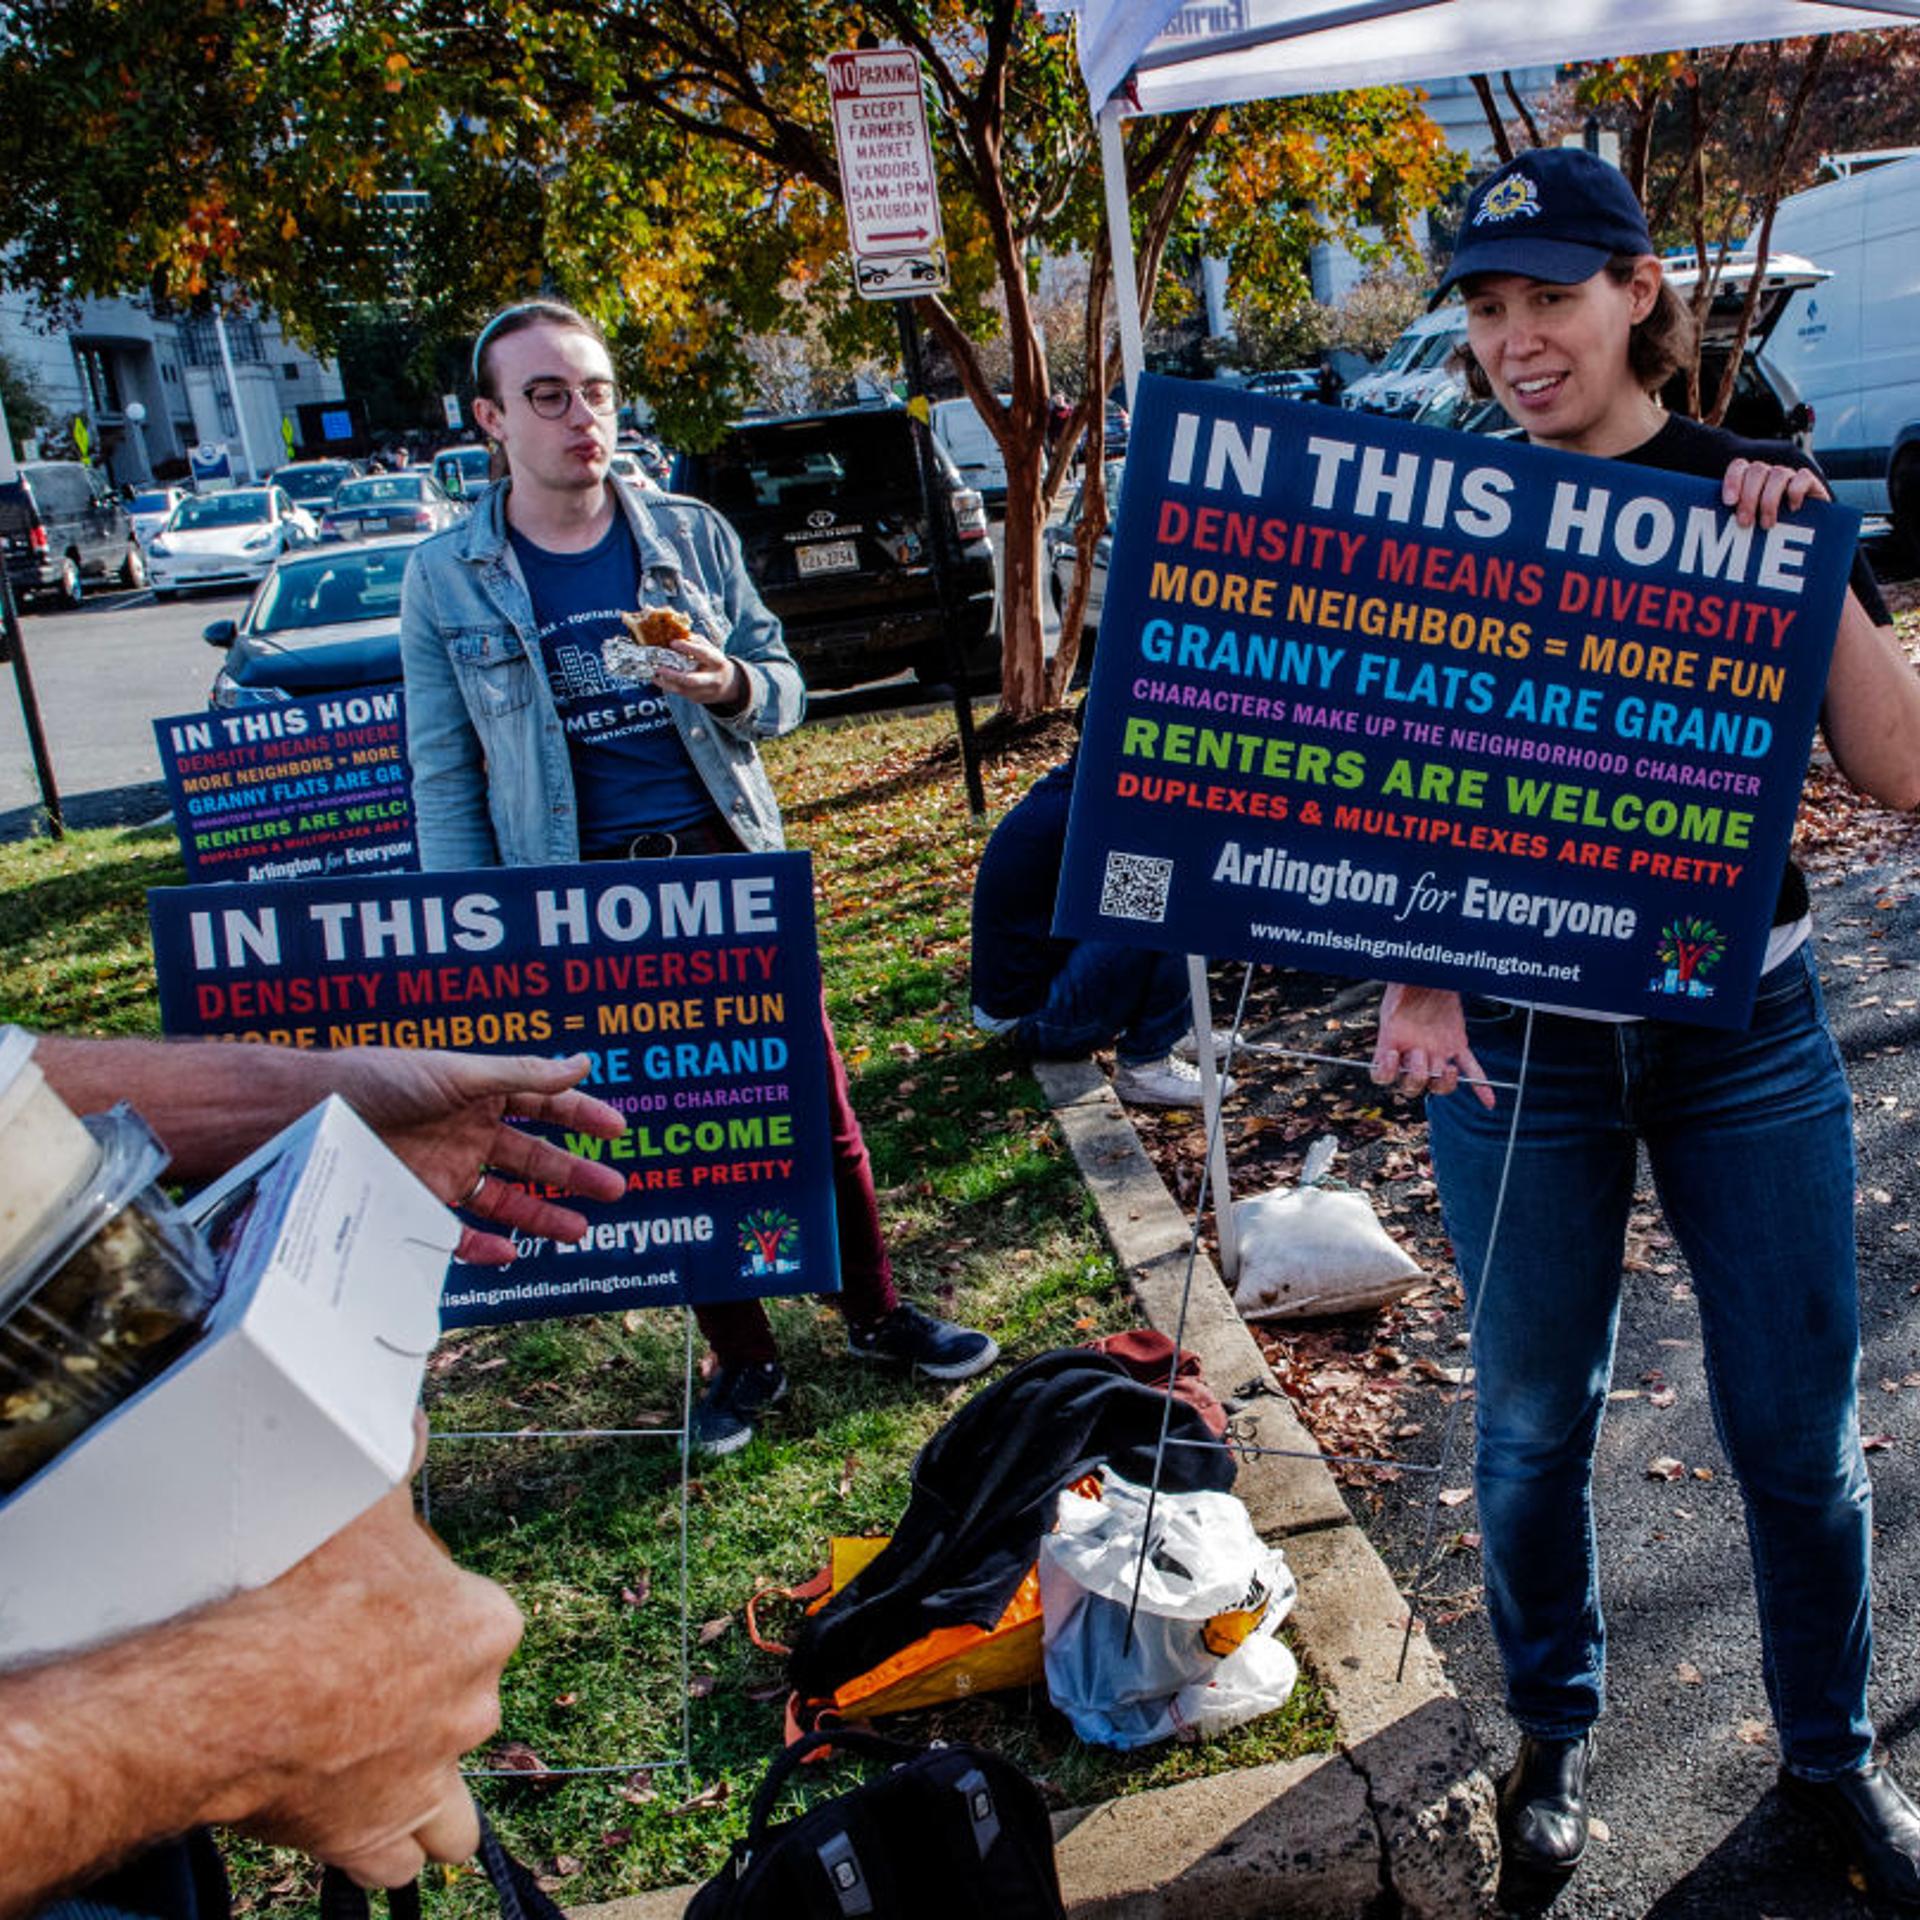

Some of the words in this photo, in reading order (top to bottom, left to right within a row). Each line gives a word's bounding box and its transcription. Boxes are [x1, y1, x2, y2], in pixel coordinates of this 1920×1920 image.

[829, 61, 858, 92] NO
[858, 64, 914, 85] PARKING
[849, 121, 915, 141] FARMERS
[852, 102, 904, 120] EXCEPT
[855, 161, 920, 180] VENDORS
[857, 142, 912, 159] MARKET
[852, 181, 929, 202] 5AM-1PM
[857, 202, 928, 222] SATURDAY
[1168, 412, 1272, 497] IN
[1307, 437, 1515, 538] THIS
[1546, 481, 1815, 593] HOME
[1157, 500, 1367, 575] DENSITY
[1377, 539, 1545, 606] MEANS
[1558, 570, 1797, 649] DIVERSITY
[1149, 562, 1278, 617] MORE
[1287, 585, 1532, 659] NEIGHBORS
[1544, 638, 1569, 656] =
[1580, 634, 1699, 688] MORE
[1707, 657, 1786, 703] FUN
[1141, 619, 1345, 689] GRANNY
[1355, 653, 1497, 714] FLATS
[1505, 679, 1605, 732] ARE
[1614, 695, 1773, 759] GRAND
[170, 722, 213, 754] IN
[221, 707, 309, 744] THIS
[318, 693, 398, 730] HOM
[566, 709, 617, 733] MES
[1132, 678, 1285, 721] CHARACTERS
[1292, 703, 1359, 732] MAKE
[1365, 714, 1397, 738] UP
[1402, 721, 1445, 746] THE
[1450, 728, 1629, 776] NEIGHBORHOOD
[1635, 757, 1761, 796] CHARACTER
[177, 747, 257, 774] DENSITY
[264, 735, 330, 759] MEANS
[182, 771, 232, 794] MORE
[237, 756, 333, 784] NEIGHBORS
[352, 744, 400, 766] MORE
[188, 786, 266, 816] GRANNY
[272, 776, 328, 802] FLATS
[334, 771, 371, 791] ARE
[1122, 717, 1367, 789] RENTERS
[1381, 759, 1489, 808] ARE
[1506, 775, 1755, 849] WELCOME
[195, 820, 292, 849] RENTERS
[299, 812, 339, 831] ARE
[345, 800, 408, 823] WELC
[1117, 772, 1288, 820] DUPLEXES
[1298, 800, 1322, 826] &
[1333, 805, 1549, 859] MULTIPLEXES
[1557, 839, 1623, 870] ARE
[1629, 850, 1743, 889] PRETTY
[248, 857, 322, 883] Arlington
[323, 851, 344, 875] for
[1212, 841, 1399, 906] Arlington
[1394, 870, 1457, 921] for
[1461, 876, 1637, 940] Everyone
[189, 907, 281, 971] IN
[308, 893, 504, 961] THIS
[536, 876, 777, 947] HOME
[1250, 921, 1581, 982] www.missingmiddlearlington.net
[197, 972, 382, 1020] DENSITY
[396, 961, 550, 1005] MEANS
[565, 945, 778, 994] DIVERSITY
[329, 1009, 552, 1049] NEIGHBORS
[564, 1015, 585, 1030] =
[598, 999, 704, 1035] MORE
[715, 992, 785, 1027] FUN
[643, 1037, 789, 1081] GRAND
[674, 1085, 790, 1109] CHARACTER
[565, 1115, 795, 1162] WELCOME
[628, 1167, 684, 1192] ARE
[693, 1159, 794, 1187] PRETTY
[442, 1269, 678, 1308] issingmiddlearlington.net
